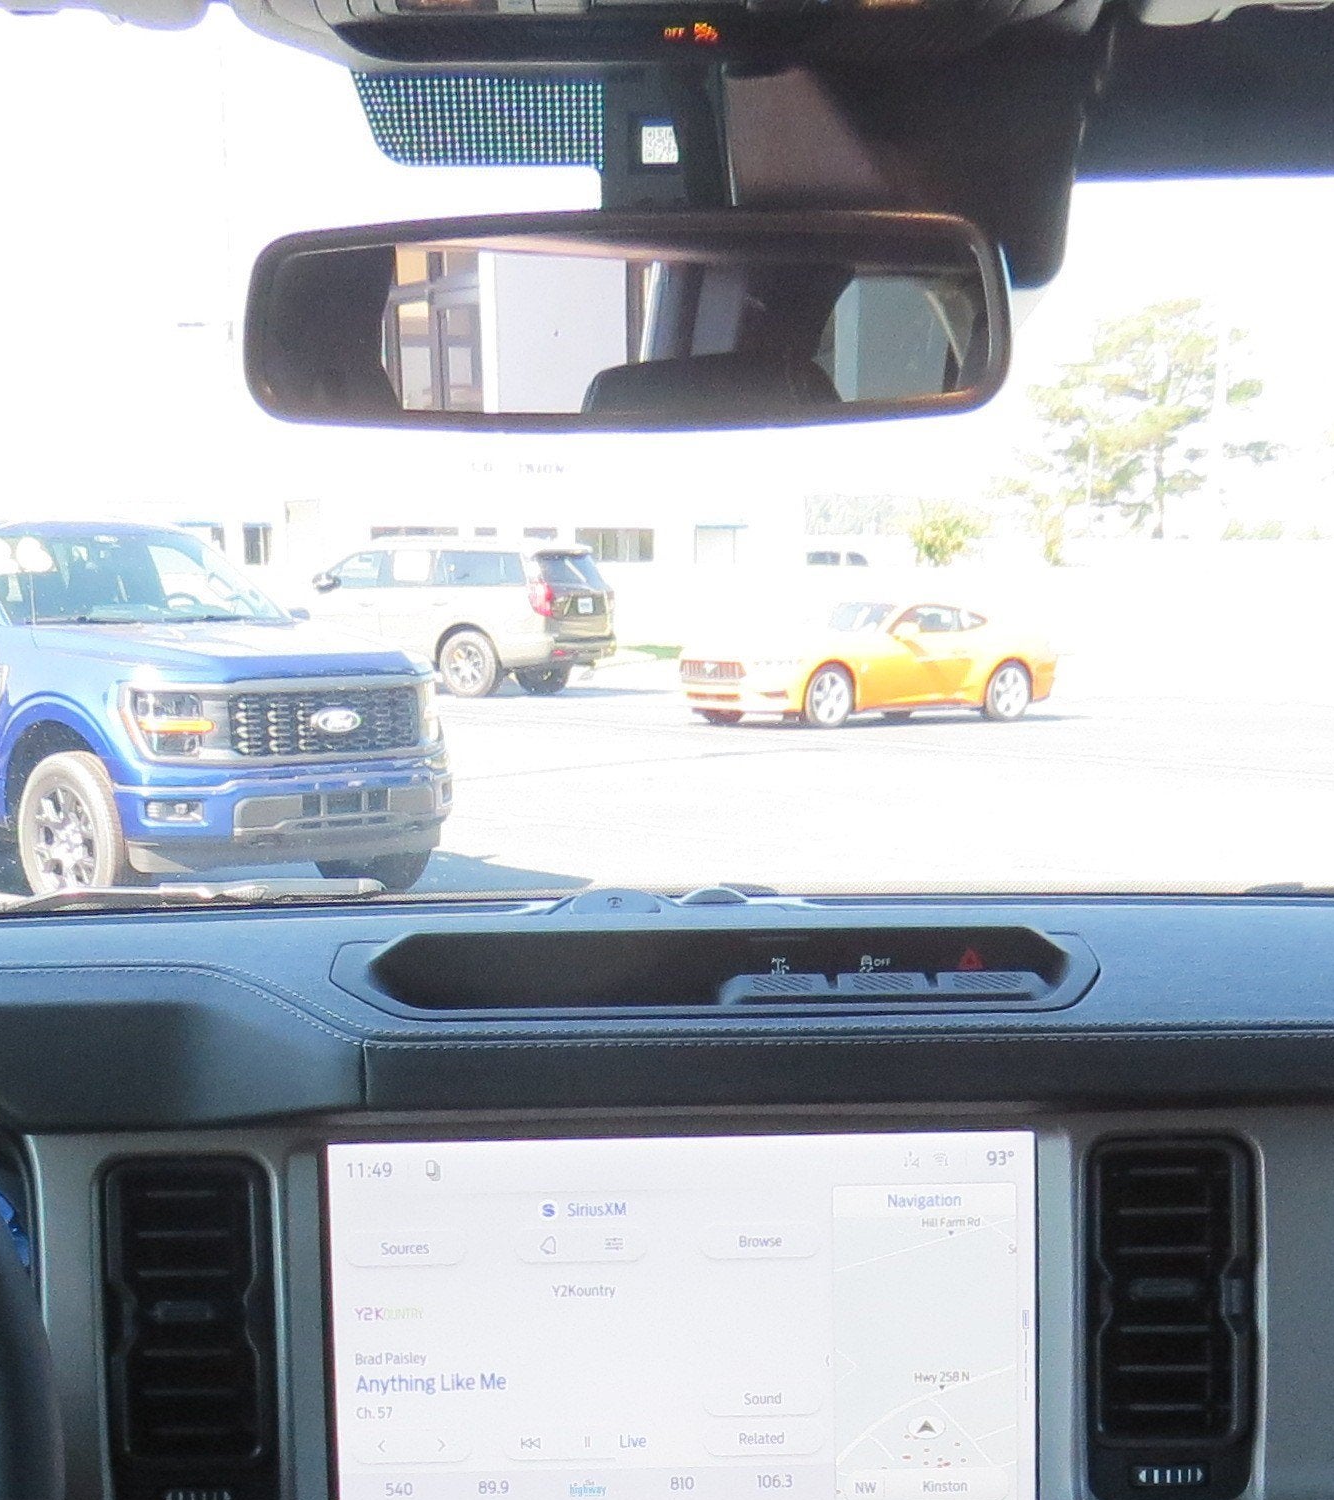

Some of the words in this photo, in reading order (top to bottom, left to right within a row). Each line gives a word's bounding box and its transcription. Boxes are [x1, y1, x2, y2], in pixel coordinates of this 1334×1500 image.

[986, 1150, 1015, 1166] 93°
[347, 1162, 393, 1179] 11:49
[887, 1193, 962, 1211] Navigation
[566, 1202, 627, 1218] SiriusXM
[921, 1217, 938, 1228] Hill
[940, 1217, 965, 1228] Farm
[967, 1216, 981, 1227] Rd
[738, 1234, 783, 1248] Browse
[380, 1242, 430, 1256] Sources
[552, 1283, 616, 1299] Y2Kountry
[354, 1352, 382, 1366] Brad
[385, 1351, 427, 1367] Paisley
[356, 1374, 437, 1396] Anything
[440, 1372, 476, 1392] Like
[480, 1372, 507, 1391] Me
[914, 1371, 937, 1384] Hwy
[939, 1371, 959, 1383] 258
[961, 1371, 970, 1382] N
[744, 1391, 782, 1406] Sound
[356, 1406, 375, 1420] Ch.
[377, 1405, 393, 1420] 57
[619, 1434, 648, 1449] Live
[738, 1432, 785, 1446] Related
[385, 1482, 413, 1496] 540
[478, 1480, 510, 1495] 89.9
[670, 1476, 695, 1491] 810
[756, 1474, 793, 1489] 106.3
[855, 1481, 877, 1494] NW
[922, 1480, 968, 1493] Kinston
